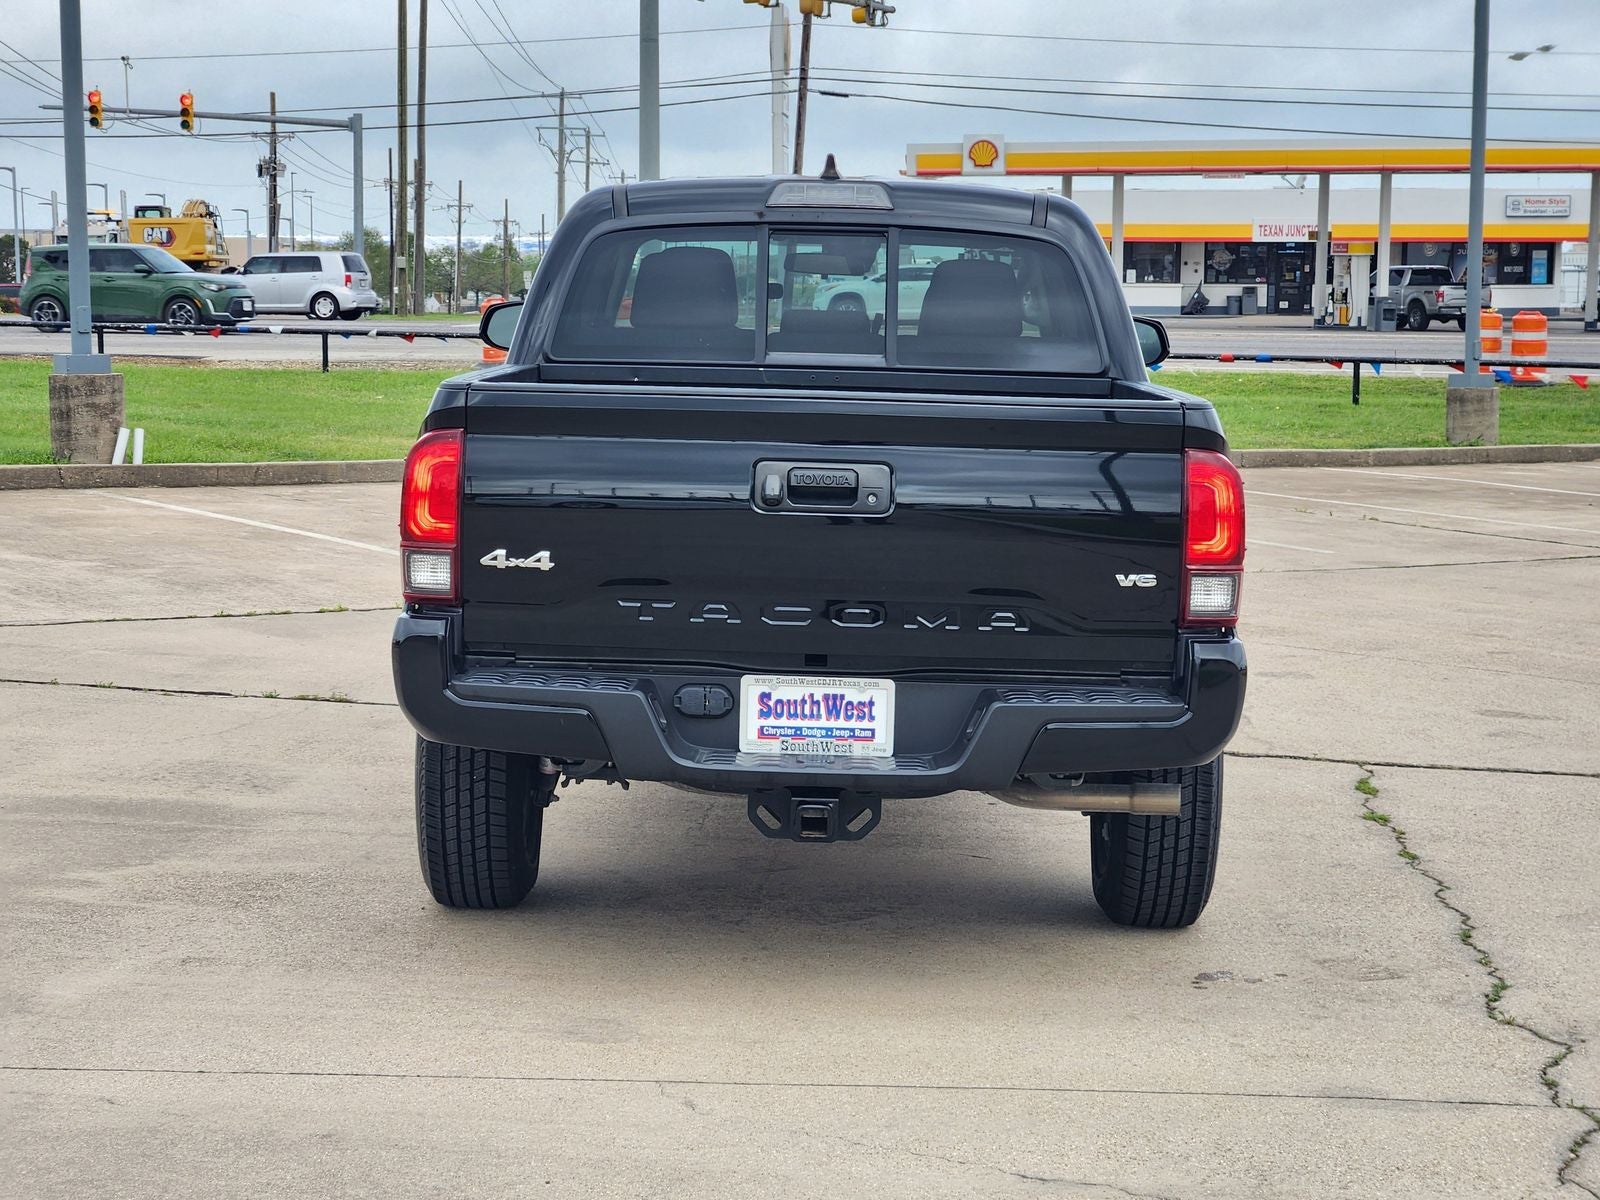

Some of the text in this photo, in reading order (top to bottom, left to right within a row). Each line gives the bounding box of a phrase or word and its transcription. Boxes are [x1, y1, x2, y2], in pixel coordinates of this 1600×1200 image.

[1548, 198, 1567, 206] Style
[143, 227, 169, 243] CAT
[1258, 224, 1284, 237] TEXAN
[793, 472, 853, 486] TOYOTA
[480, 548, 555, 571] 4x4
[1114, 573, 1158, 588] V6
[616, 599, 1031, 632] TACOMA
[757, 691, 876, 722] SouthWest
[763, 726, 872, 739] Chrysler Dodge Jeep Ram
[780, 739, 854, 754] SouthWest
